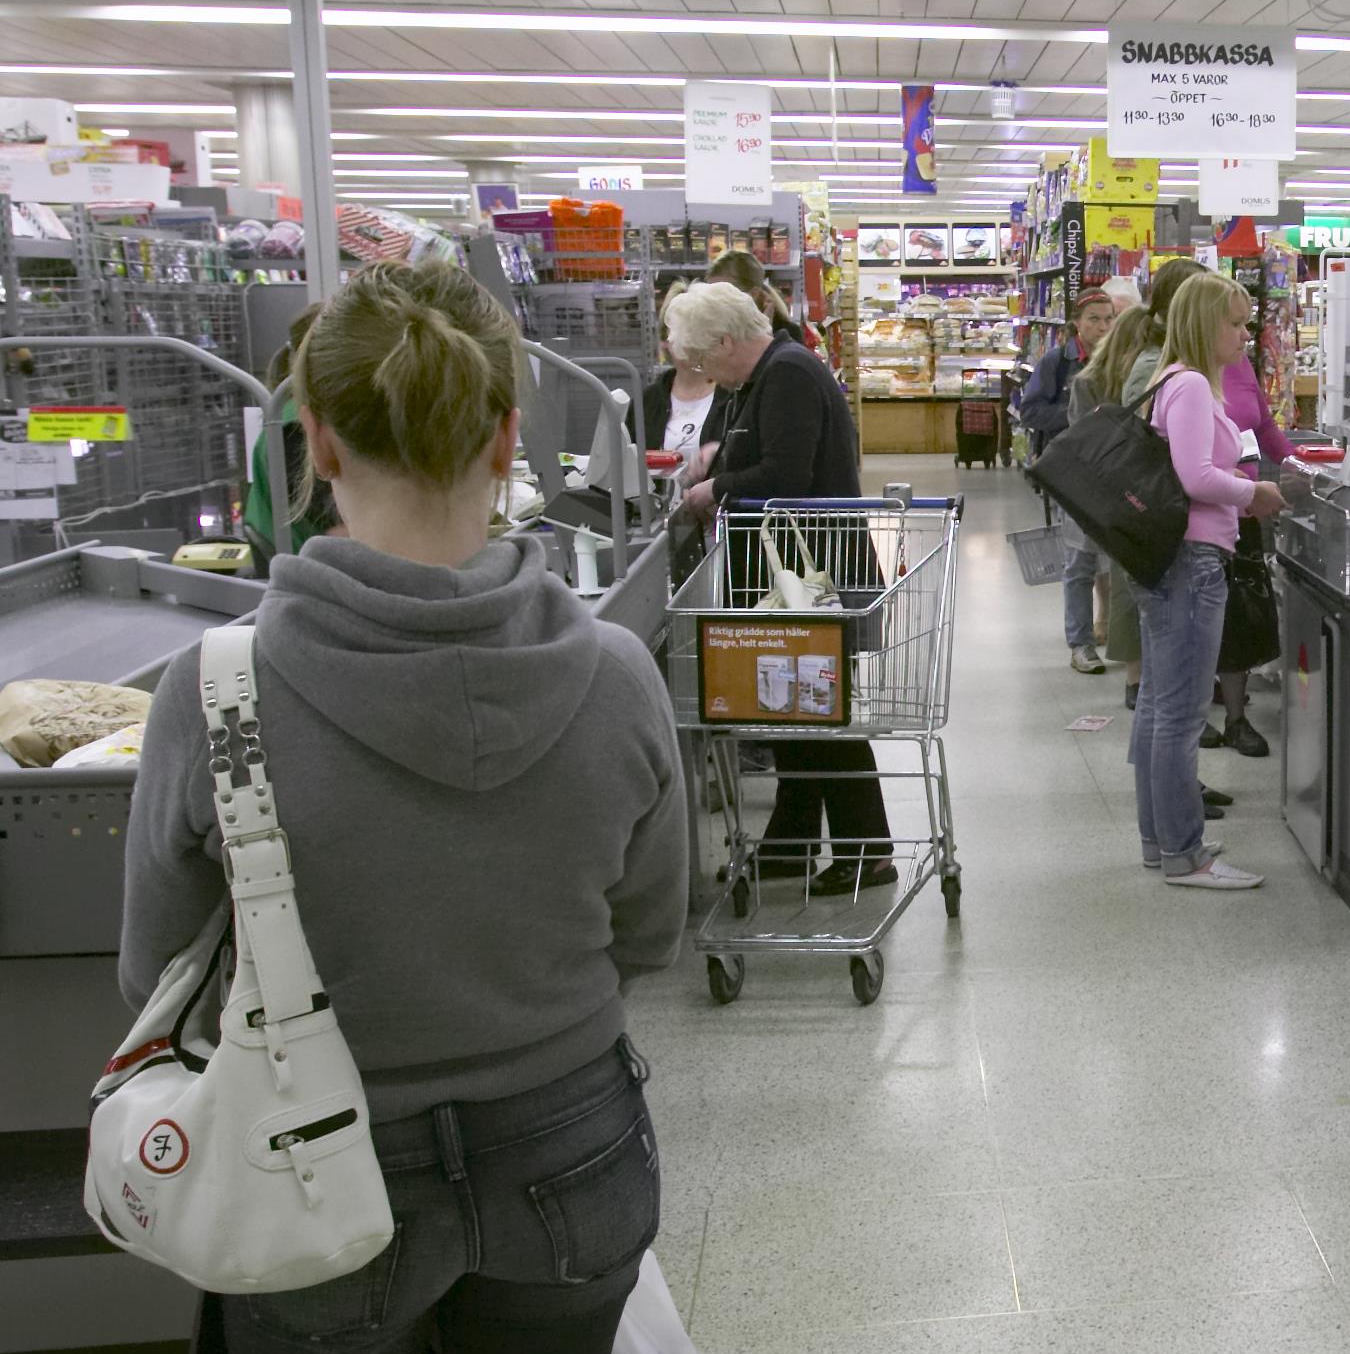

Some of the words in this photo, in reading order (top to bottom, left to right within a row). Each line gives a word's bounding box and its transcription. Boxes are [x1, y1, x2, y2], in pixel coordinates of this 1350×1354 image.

[1121, 40, 1274, 67] SNABBKASSA
[1151, 73, 1177, 85] MAX
[1182, 73, 1190, 85] 5
[1193, 74, 1228, 86] VAROR
[1170, 90, 1207, 104] ÖPPET
[731, 185, 765, 194] DOMUS
[1241, 197, 1271, 205] DOMUS
[708, 627, 734, 638] Riktig
[735, 627, 765, 638] grädde
[785, 627, 810, 637] håller
[708, 639, 739, 649] längre,
[739, 639, 757, 648] helt
[757, 639, 788, 648] enkelt.
